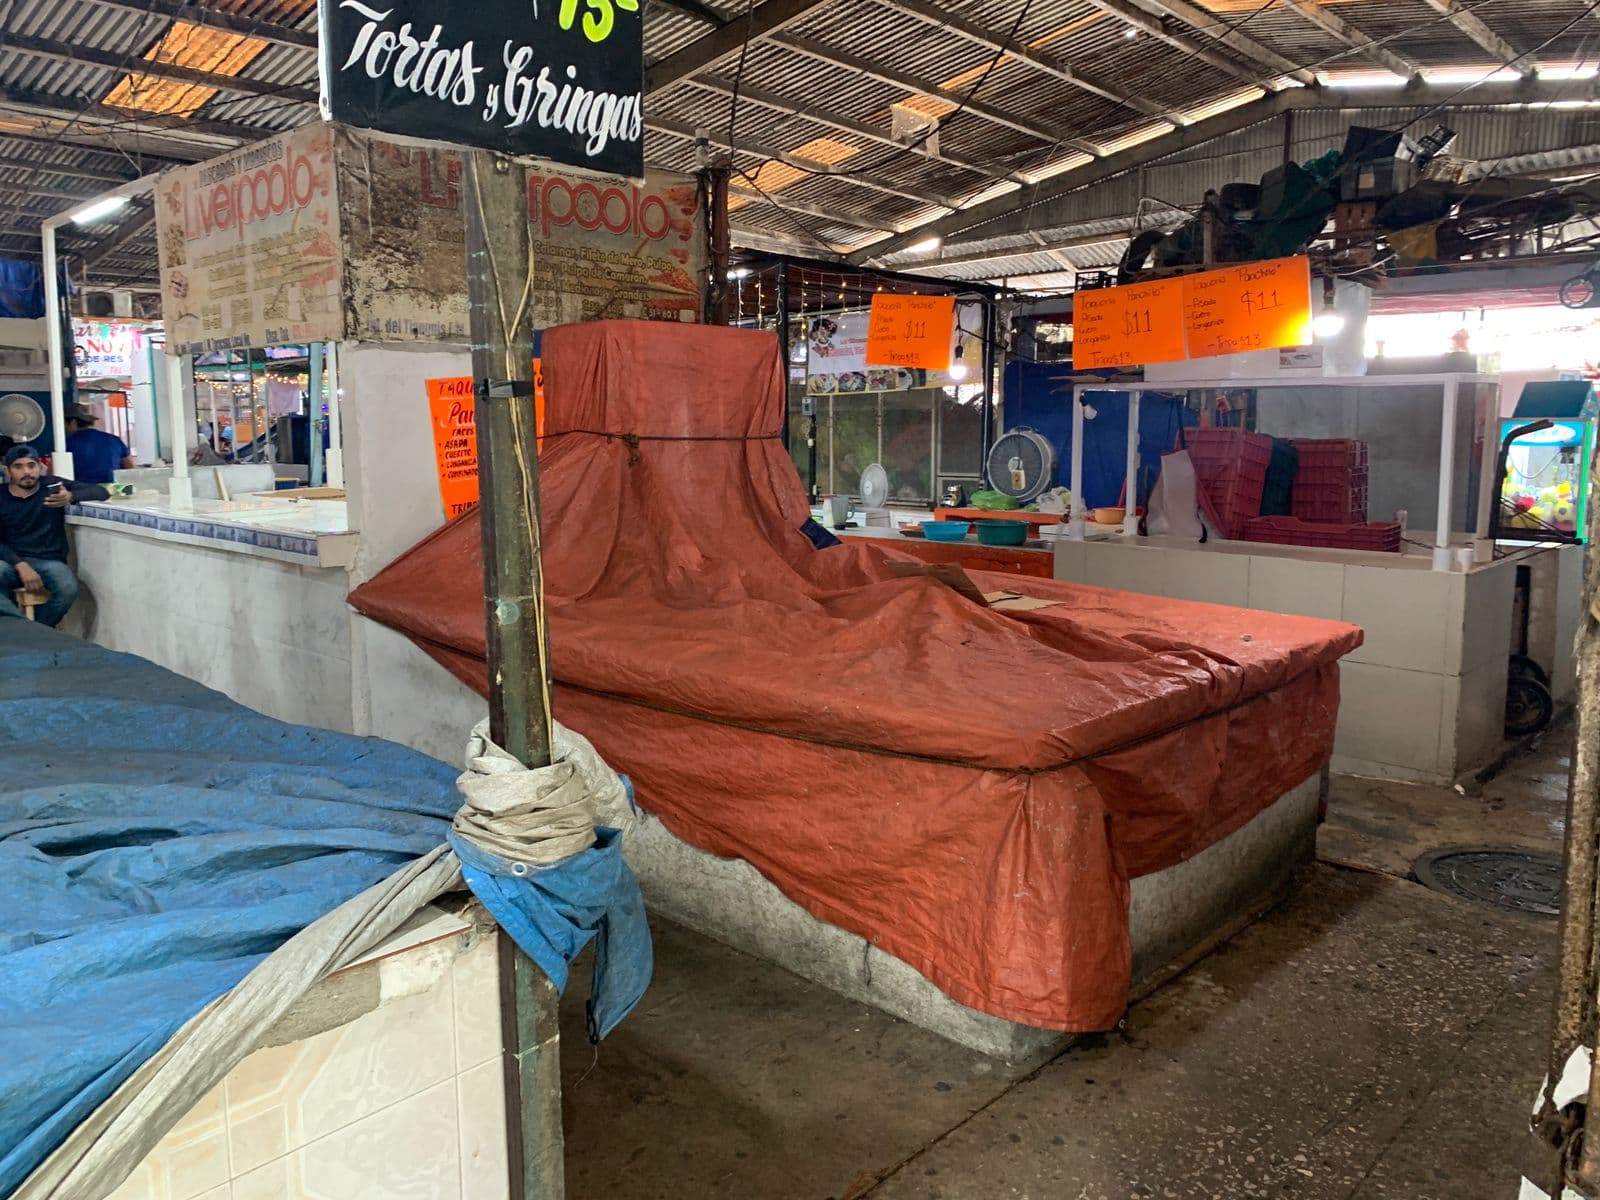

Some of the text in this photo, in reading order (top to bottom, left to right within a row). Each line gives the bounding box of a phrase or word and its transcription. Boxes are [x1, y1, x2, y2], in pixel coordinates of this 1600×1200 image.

[340, 0, 644, 157] Tortas y Gringas
